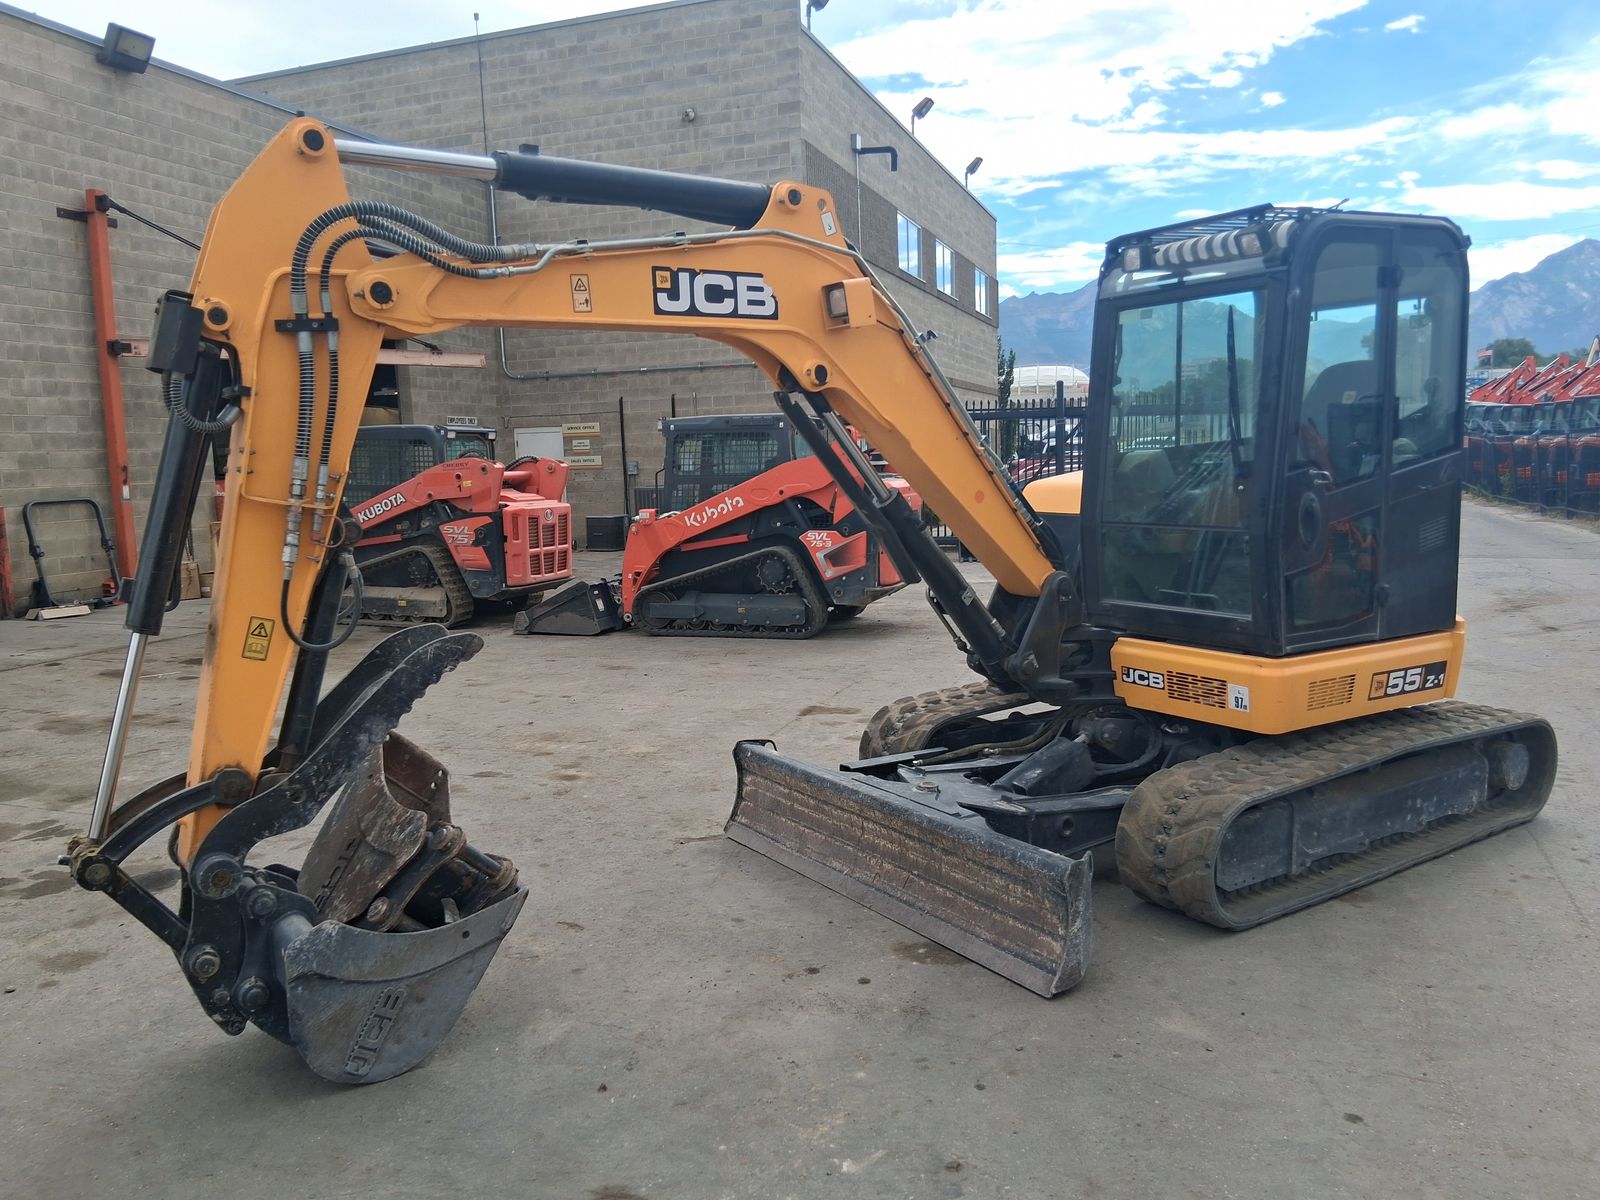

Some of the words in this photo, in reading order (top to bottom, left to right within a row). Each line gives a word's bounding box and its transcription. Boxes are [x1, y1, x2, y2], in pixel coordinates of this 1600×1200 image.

[656, 271, 776, 315] JCB
[457, 484, 463, 493] 1
[357, 492, 406, 523] KUBOTA
[684, 496, 745, 527] Kubota
[443, 526, 474, 535] SVL
[806, 532, 831, 540] SVL
[1122, 668, 1164, 689] JCB
[1386, 668, 1423, 695] 55
[1424, 673, 1445, 688] Z-1
[1234, 696, 1243, 709] 97
